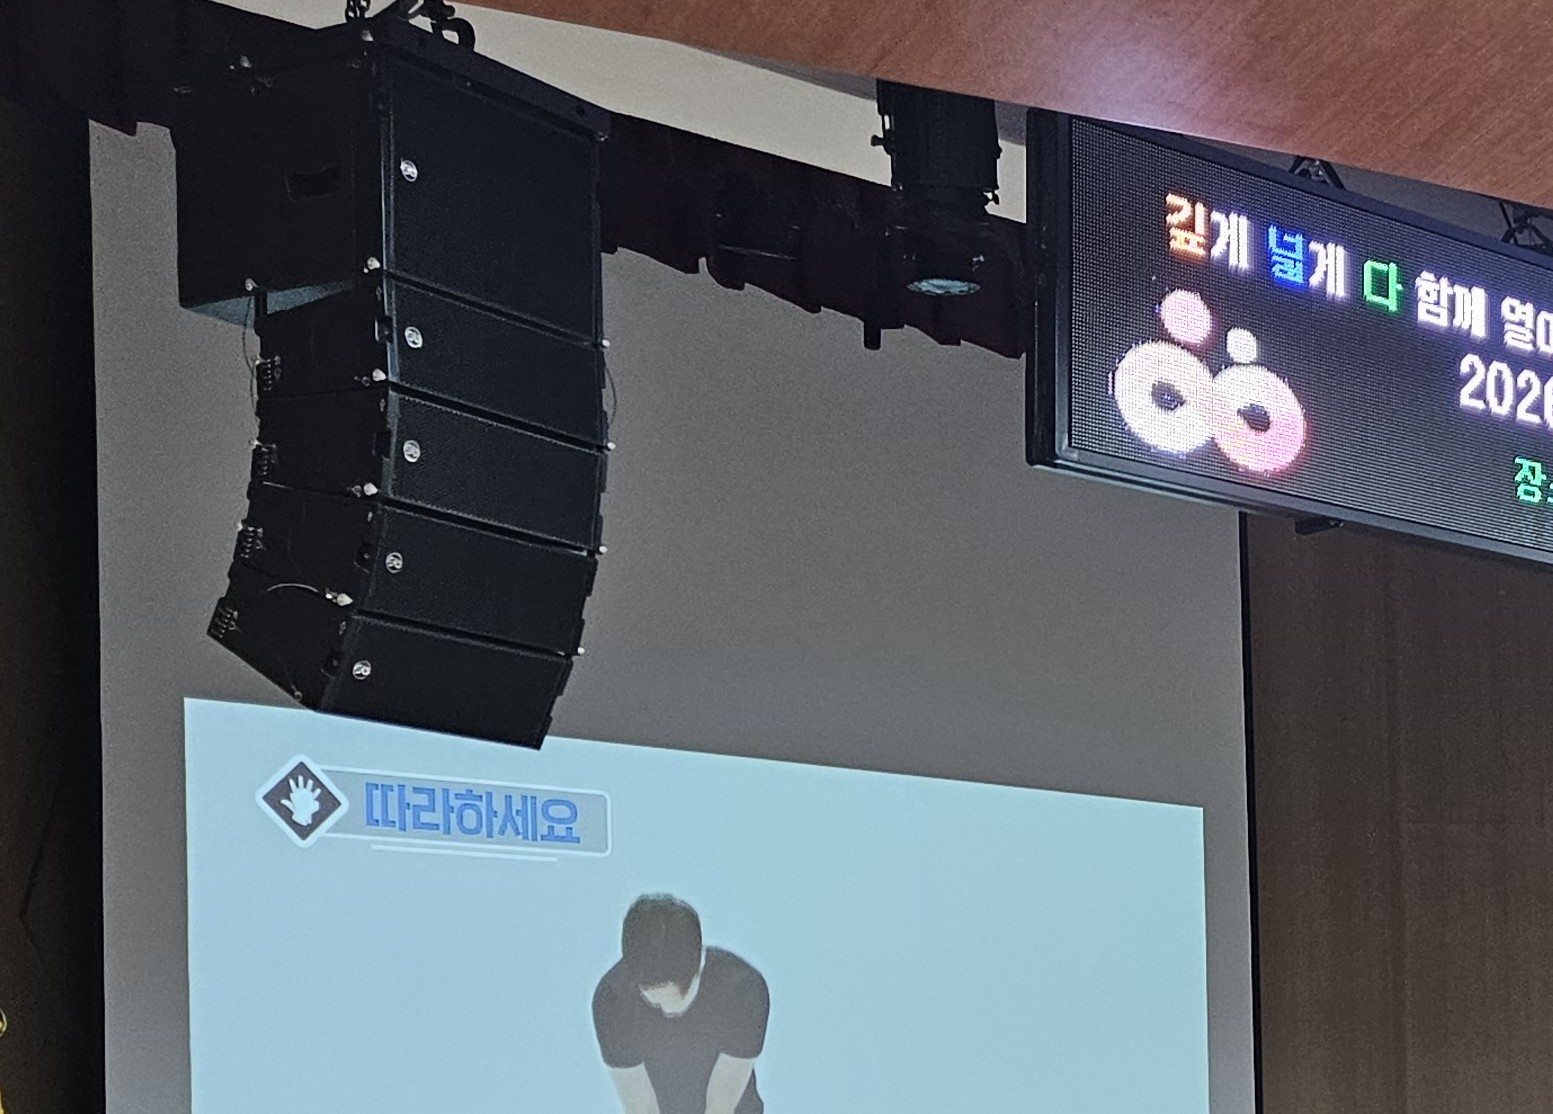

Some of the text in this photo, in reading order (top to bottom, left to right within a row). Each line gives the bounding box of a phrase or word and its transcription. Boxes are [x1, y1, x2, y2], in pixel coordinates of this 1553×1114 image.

[1166, 192, 1250, 270] 깊게
[1268, 223, 1346, 298] 넓게
[1363, 259, 1403, 312] 다
[1416, 271, 1488, 340] 함께
[364, 781, 581, 844] 따라하세요
